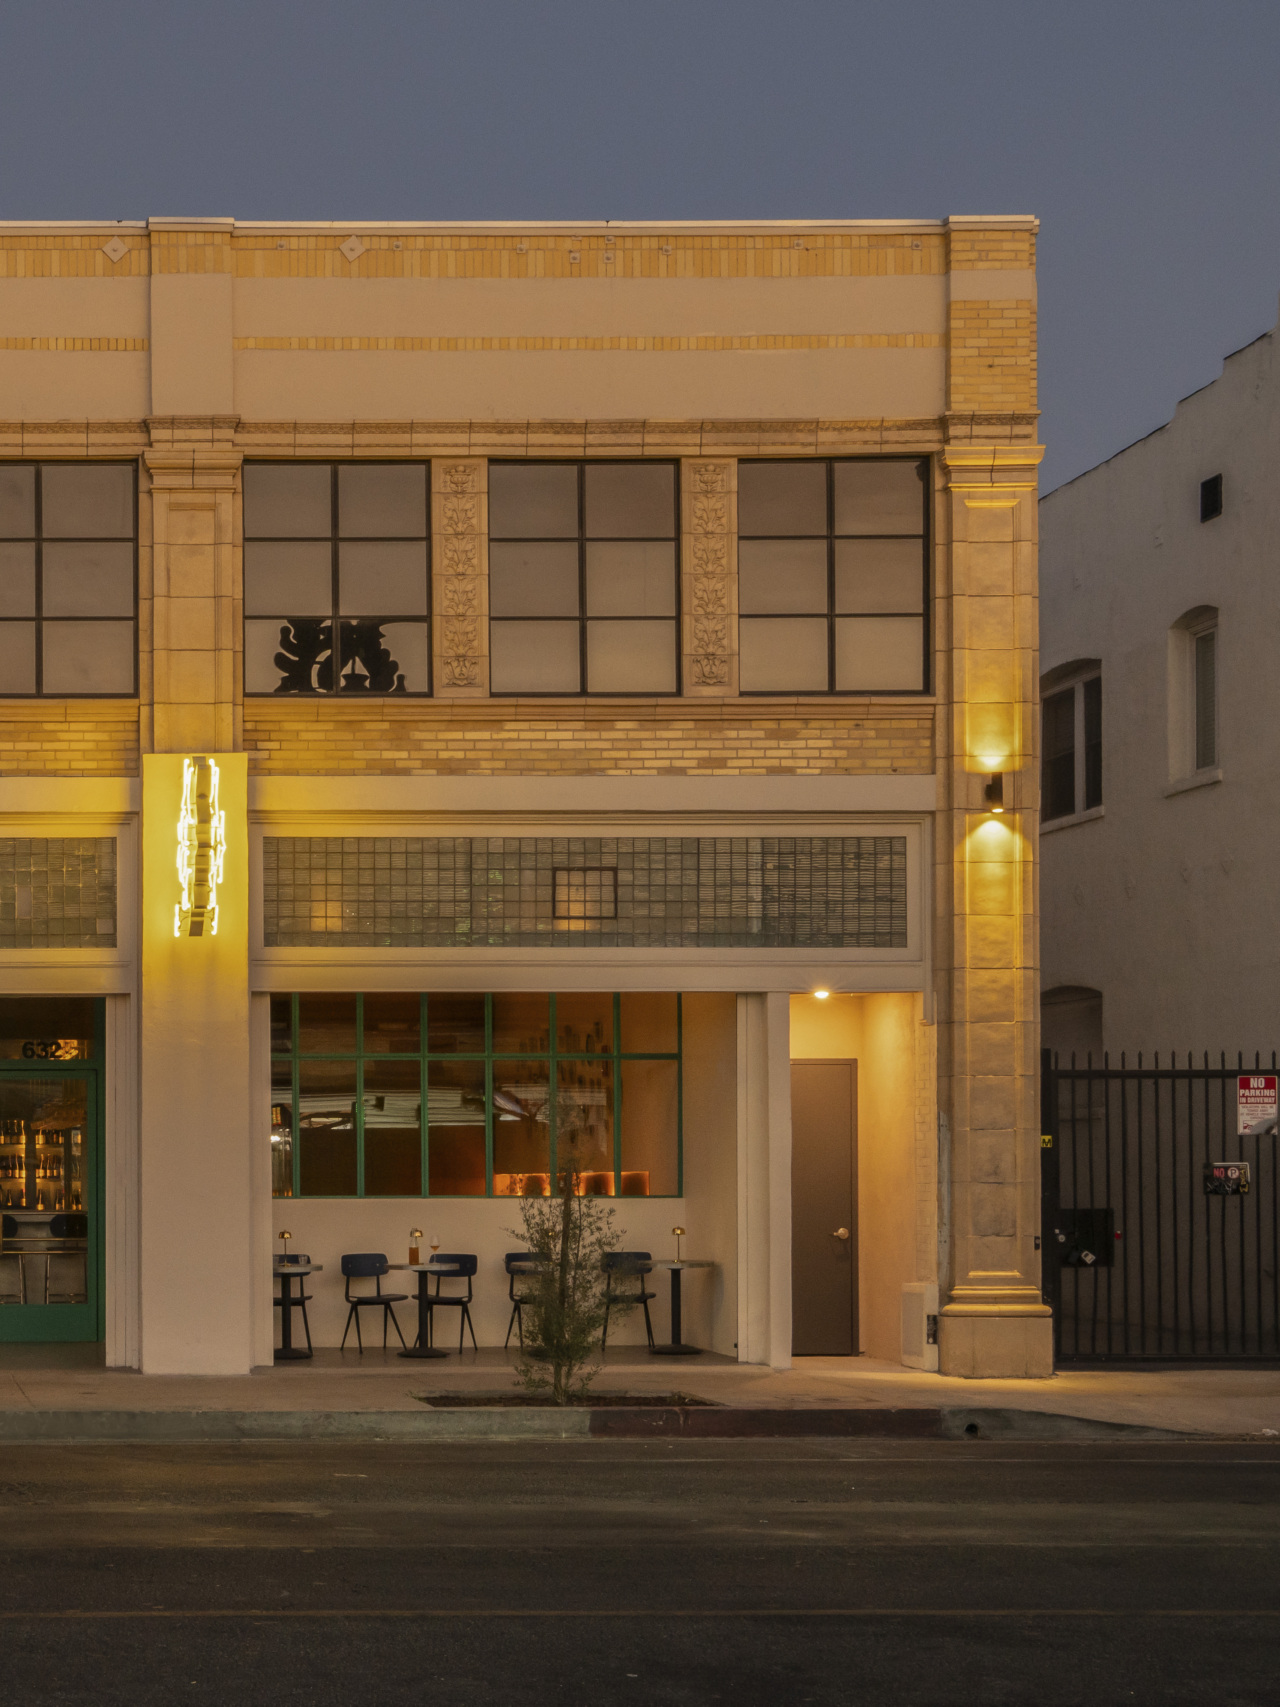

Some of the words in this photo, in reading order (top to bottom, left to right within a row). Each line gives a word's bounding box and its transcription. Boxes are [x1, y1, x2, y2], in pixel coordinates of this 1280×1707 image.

[22, 1042, 62, 1058] 632
[1250, 1078, 1265, 1088] NO
[1213, 1167, 1225, 1178] NO
